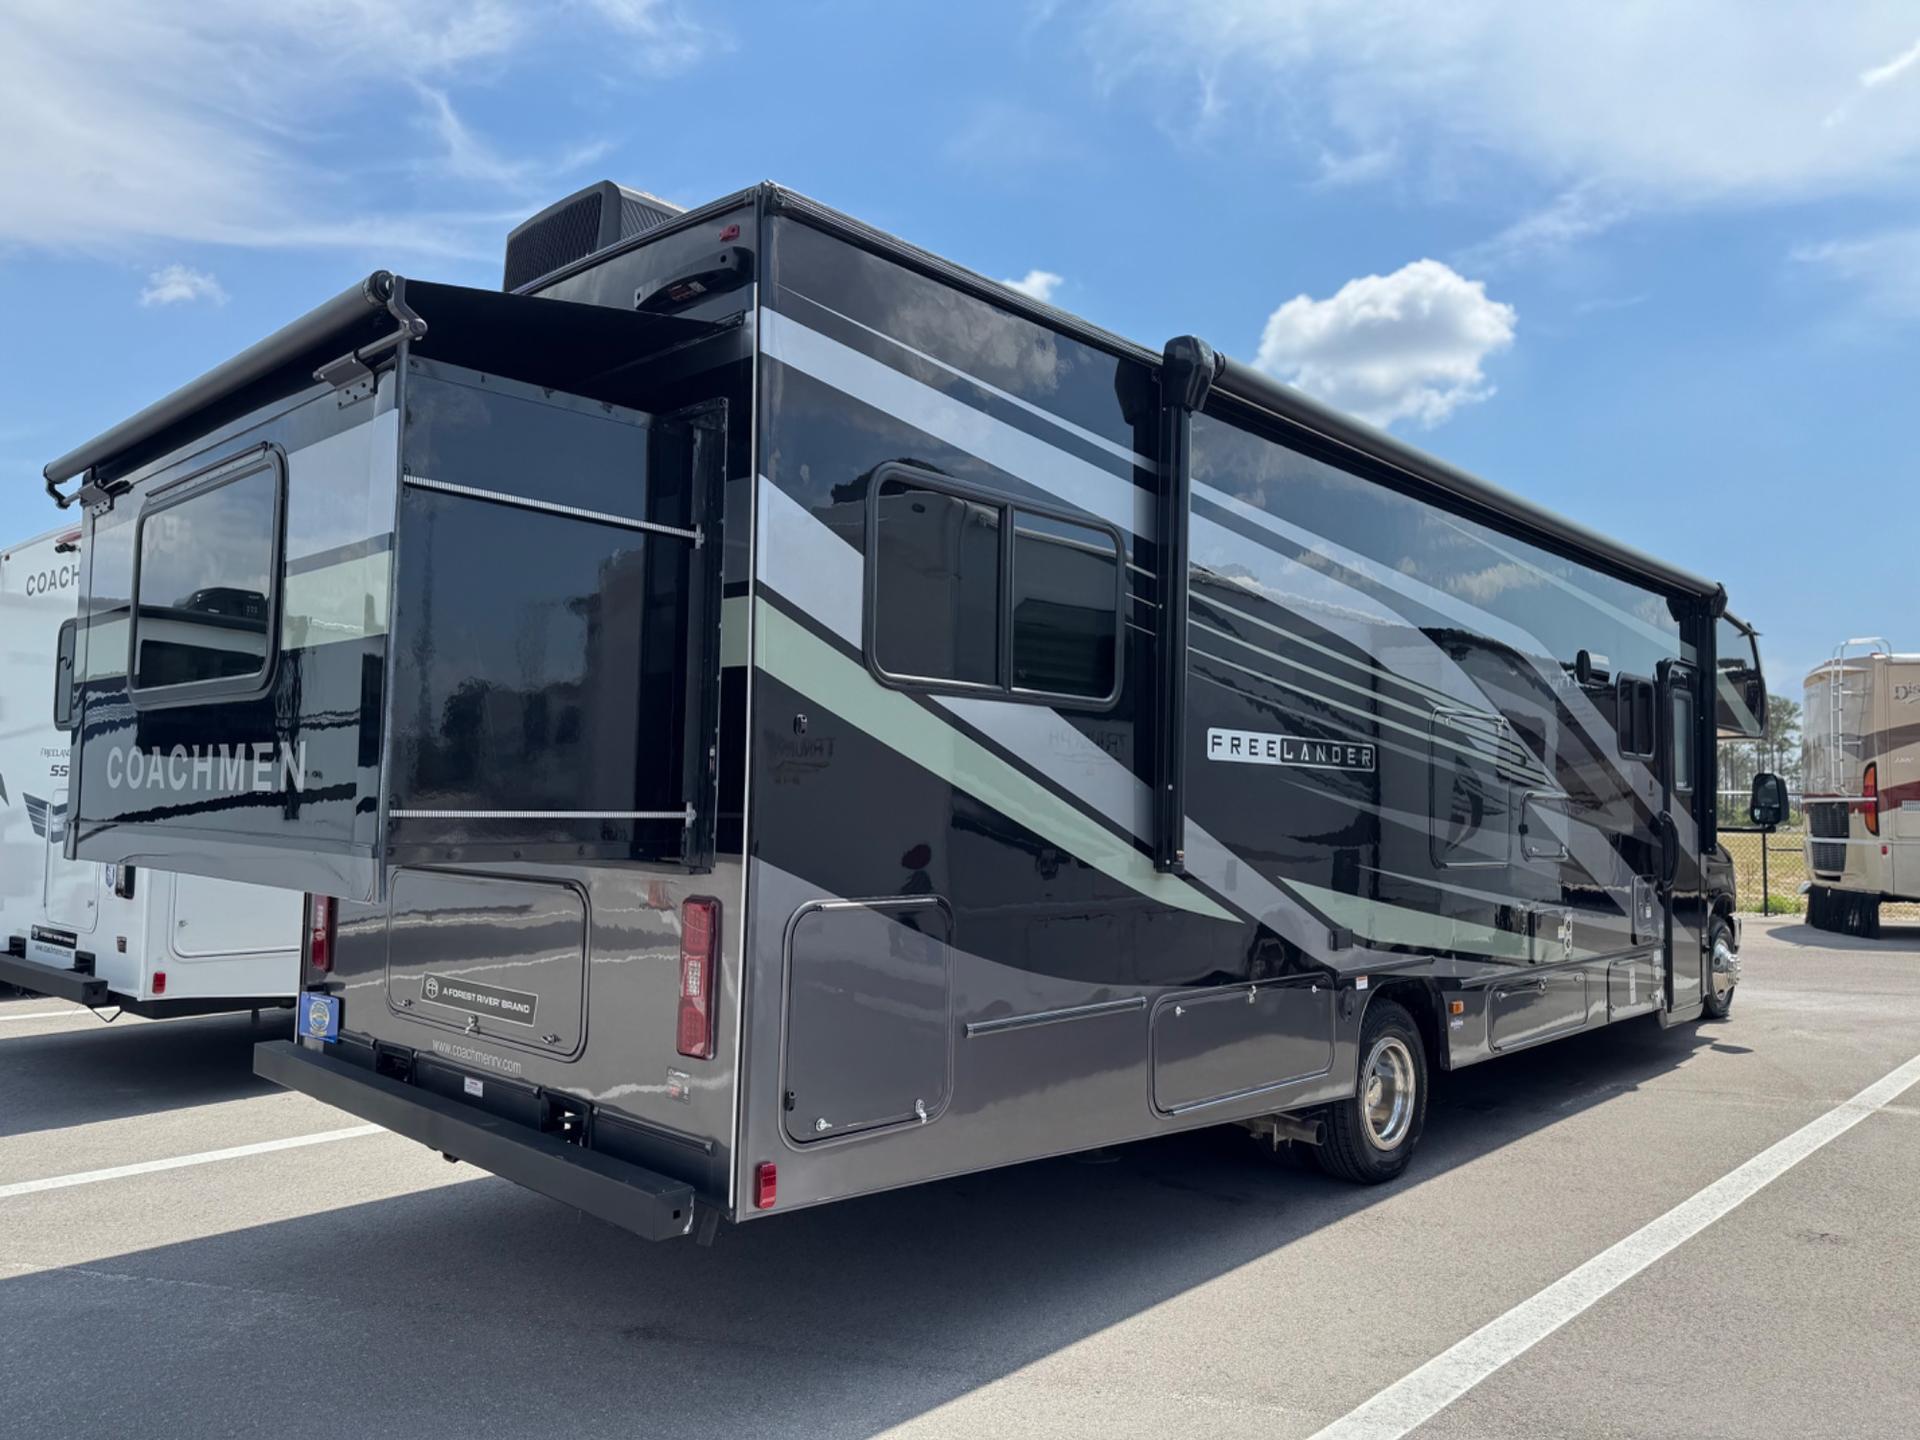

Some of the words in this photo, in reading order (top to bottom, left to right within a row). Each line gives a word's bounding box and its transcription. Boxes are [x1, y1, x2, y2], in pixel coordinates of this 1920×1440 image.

[106, 741, 306, 793] COACHMEN
[1211, 735, 1371, 767] FREELANDER
[442, 987, 448, 996] A
[448, 988, 475, 1002] FOREST
[477, 994, 500, 1007] RIVER
[501, 999, 530, 1013] BRAND
[432, 1039, 522, 1074] www.coachmenrv.com
